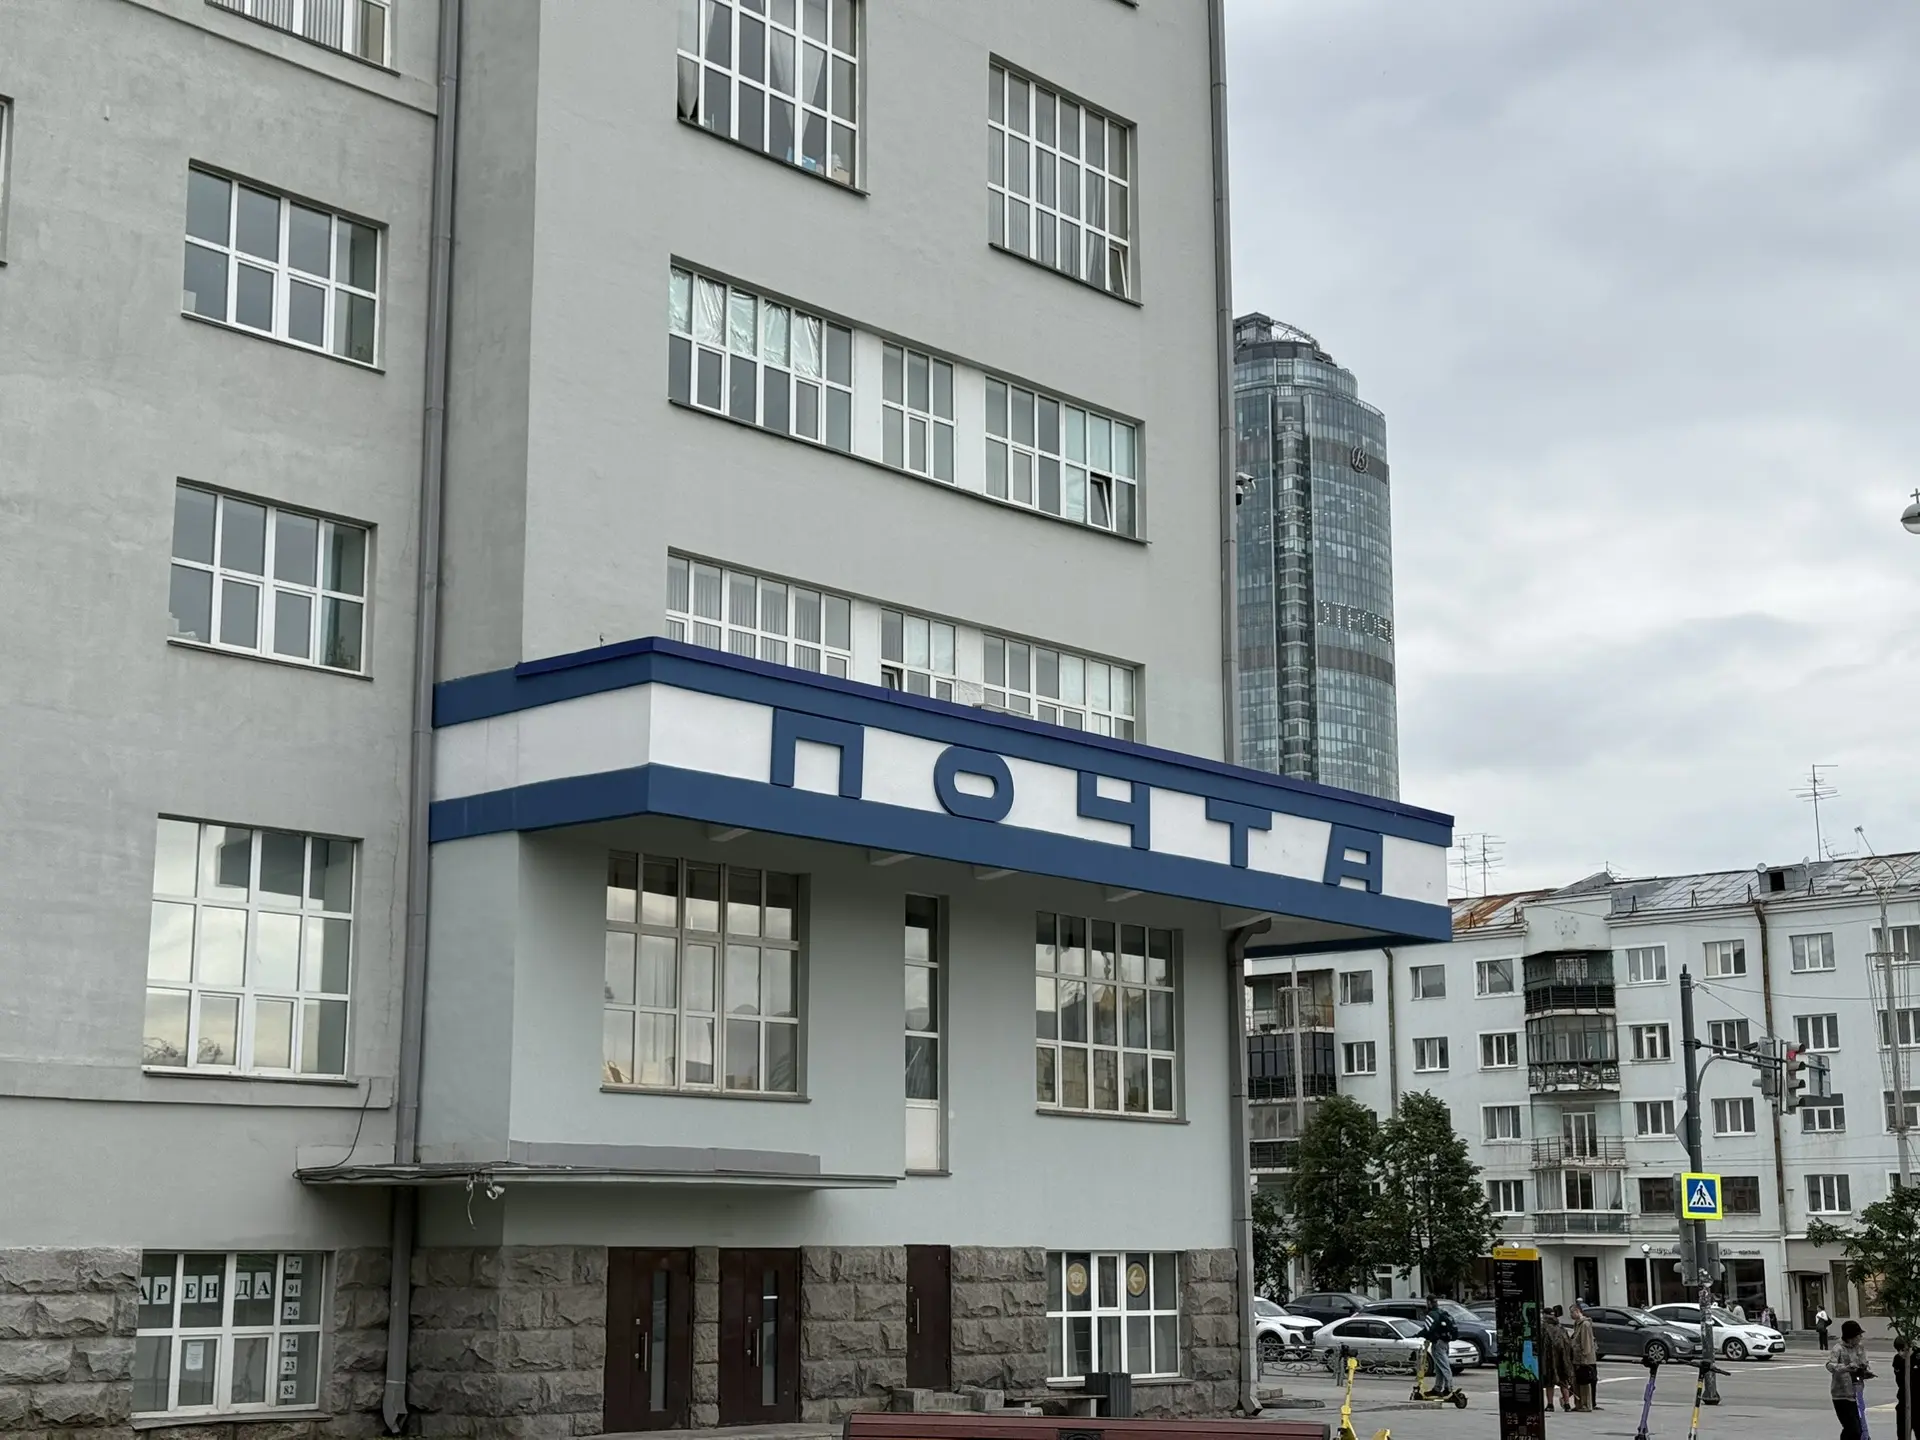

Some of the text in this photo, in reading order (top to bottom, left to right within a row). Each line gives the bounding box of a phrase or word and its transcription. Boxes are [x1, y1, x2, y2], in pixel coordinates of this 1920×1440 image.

[769, 706, 1383, 894] ПОЧТА
[288, 1260, 301, 1270] +7
[139, 1279, 271, 1301] АРЕНДА
[288, 1283, 299, 1294] 91
[287, 1306, 298, 1316] 26
[286, 1339, 297, 1349] 74
[284, 1361, 295, 1371] 23
[283, 1385, 295, 1395] 82
